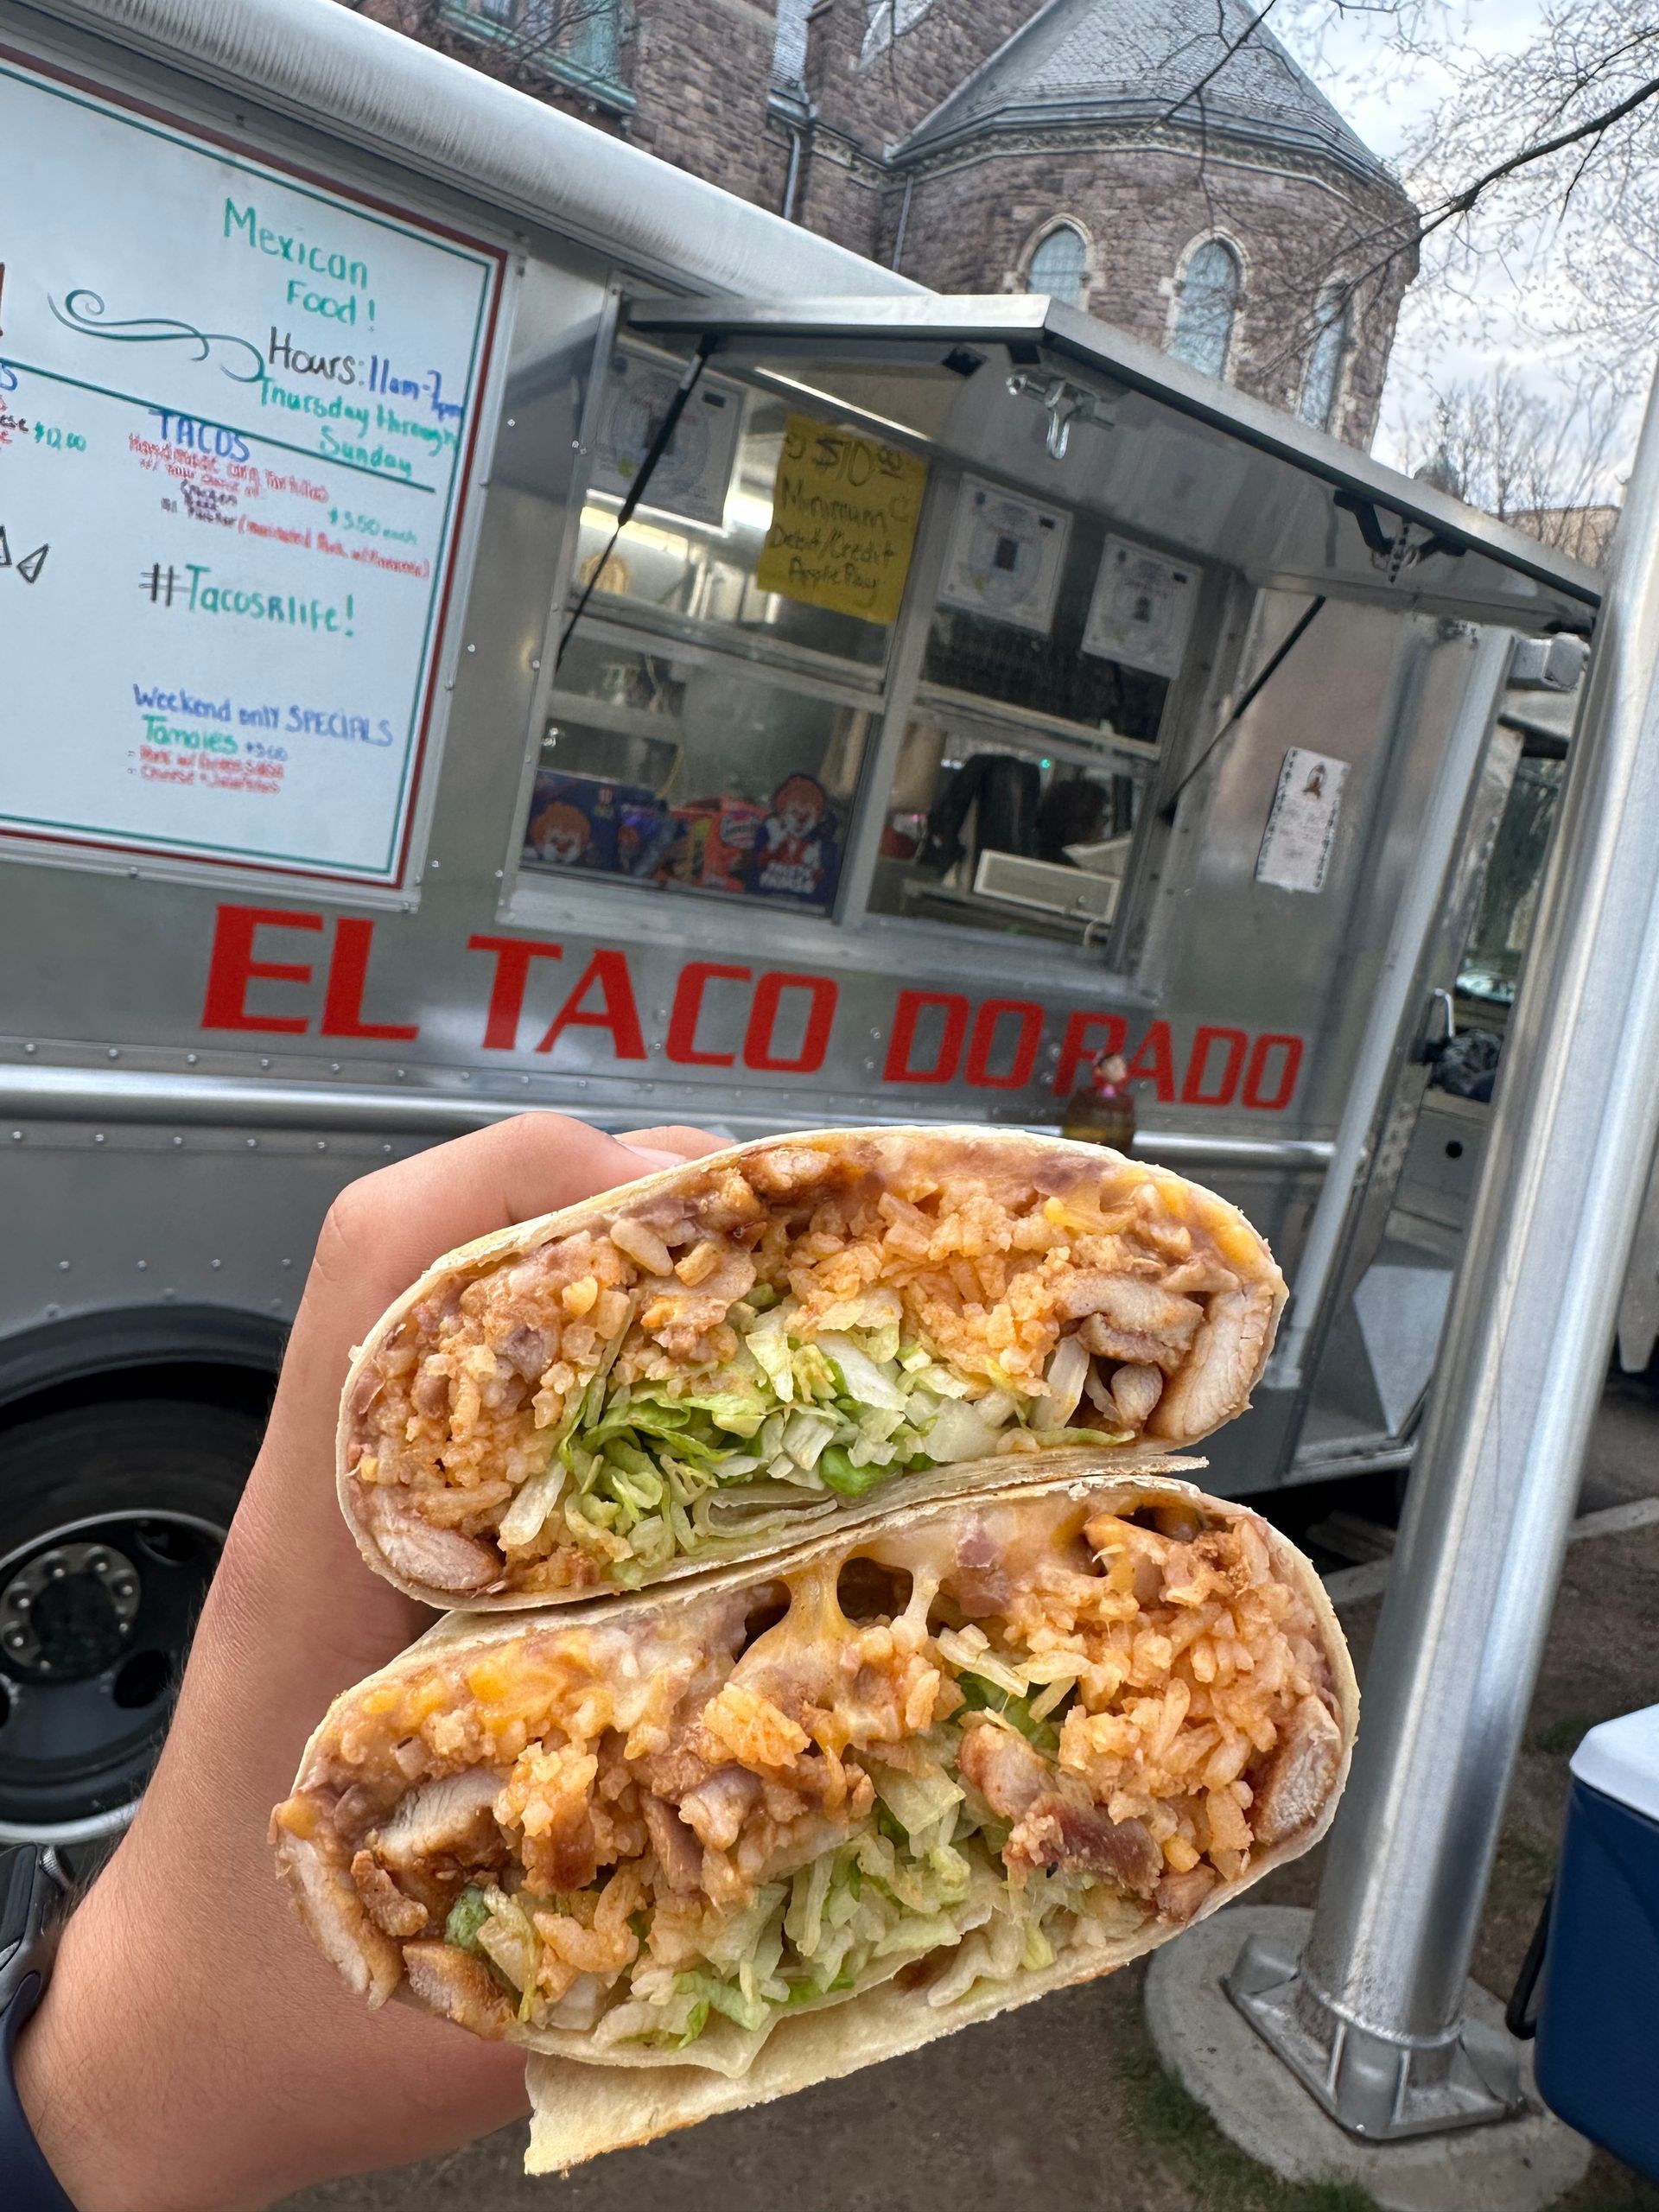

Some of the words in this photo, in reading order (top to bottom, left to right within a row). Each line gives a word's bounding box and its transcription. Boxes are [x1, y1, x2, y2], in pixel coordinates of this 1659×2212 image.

[224, 197, 367, 289] Mexican
[148, 408, 251, 463] TACOS
[319, 424, 412, 480] Sunday
[132, 683, 232, 723] Weekend
[285, 704, 394, 747] SPECIALS
[200, 903, 420, 1042] EL
[466, 933, 839, 1072] TACO
[882, 989, 1304, 1111] DORADO
